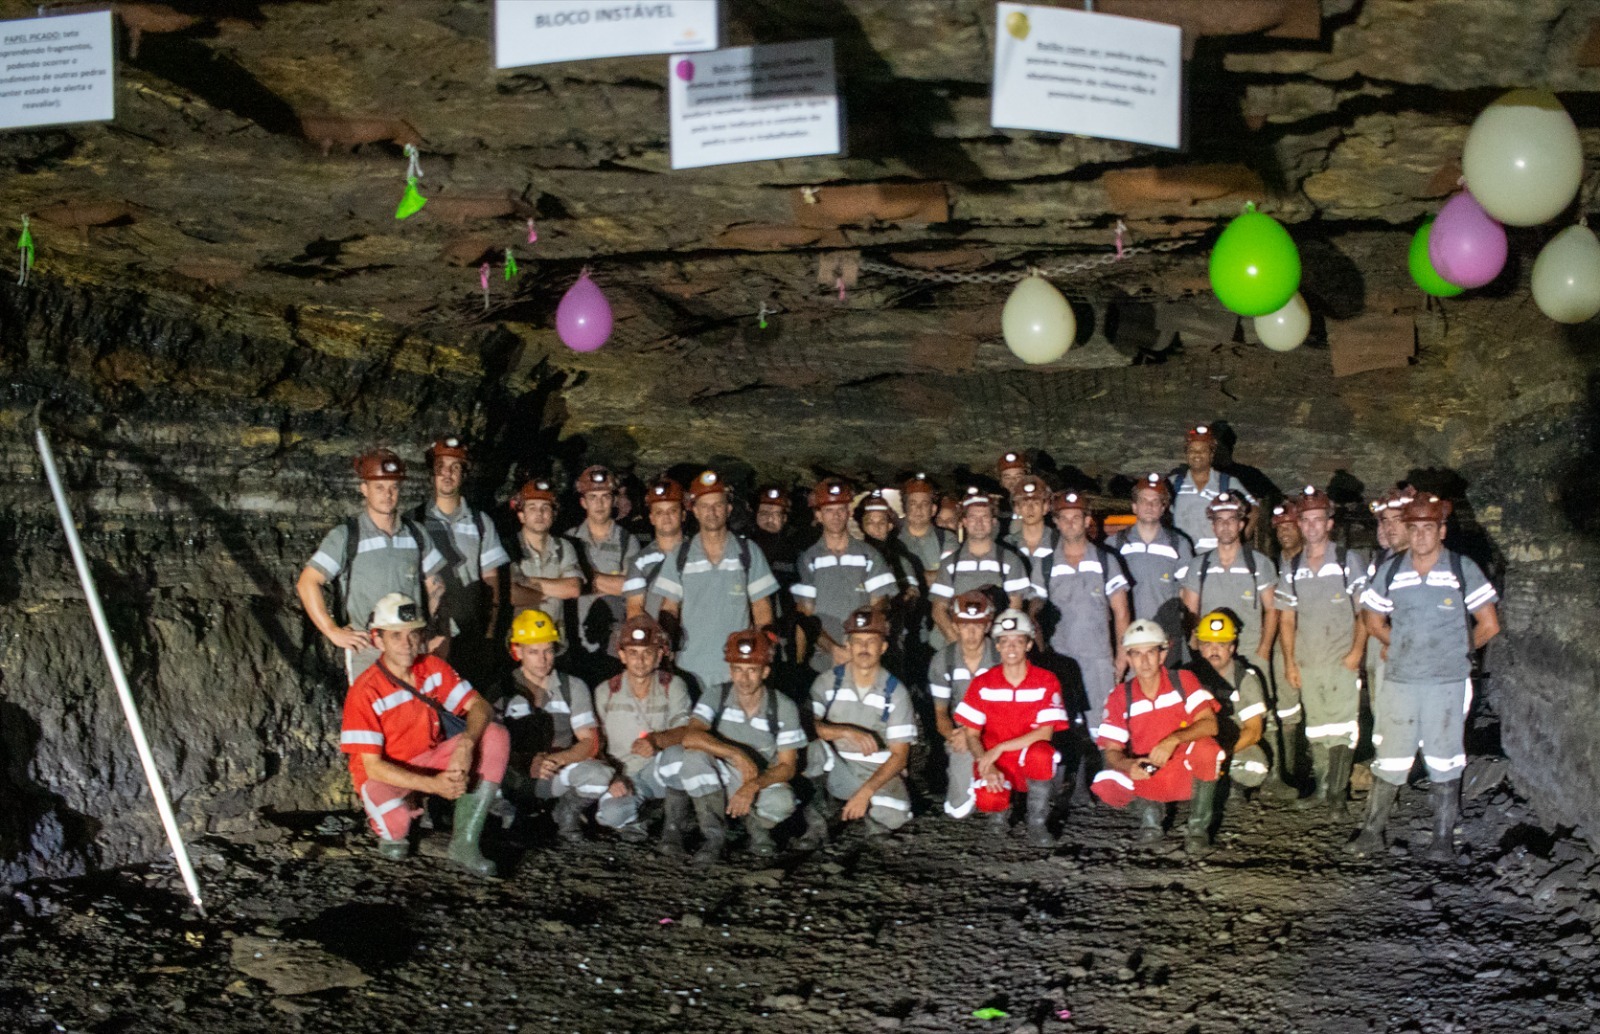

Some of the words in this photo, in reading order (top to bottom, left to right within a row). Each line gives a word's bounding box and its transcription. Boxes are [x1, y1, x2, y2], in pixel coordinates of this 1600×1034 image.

[536, 11, 590, 28] BLOCO
[595, 3, 675, 22] INSTÁVEL
[4, 33, 27, 43] PAPEL
[6, 61, 40, 71] podendo
[42, 72, 52, 80] de
[52, 85, 61, 93] de
